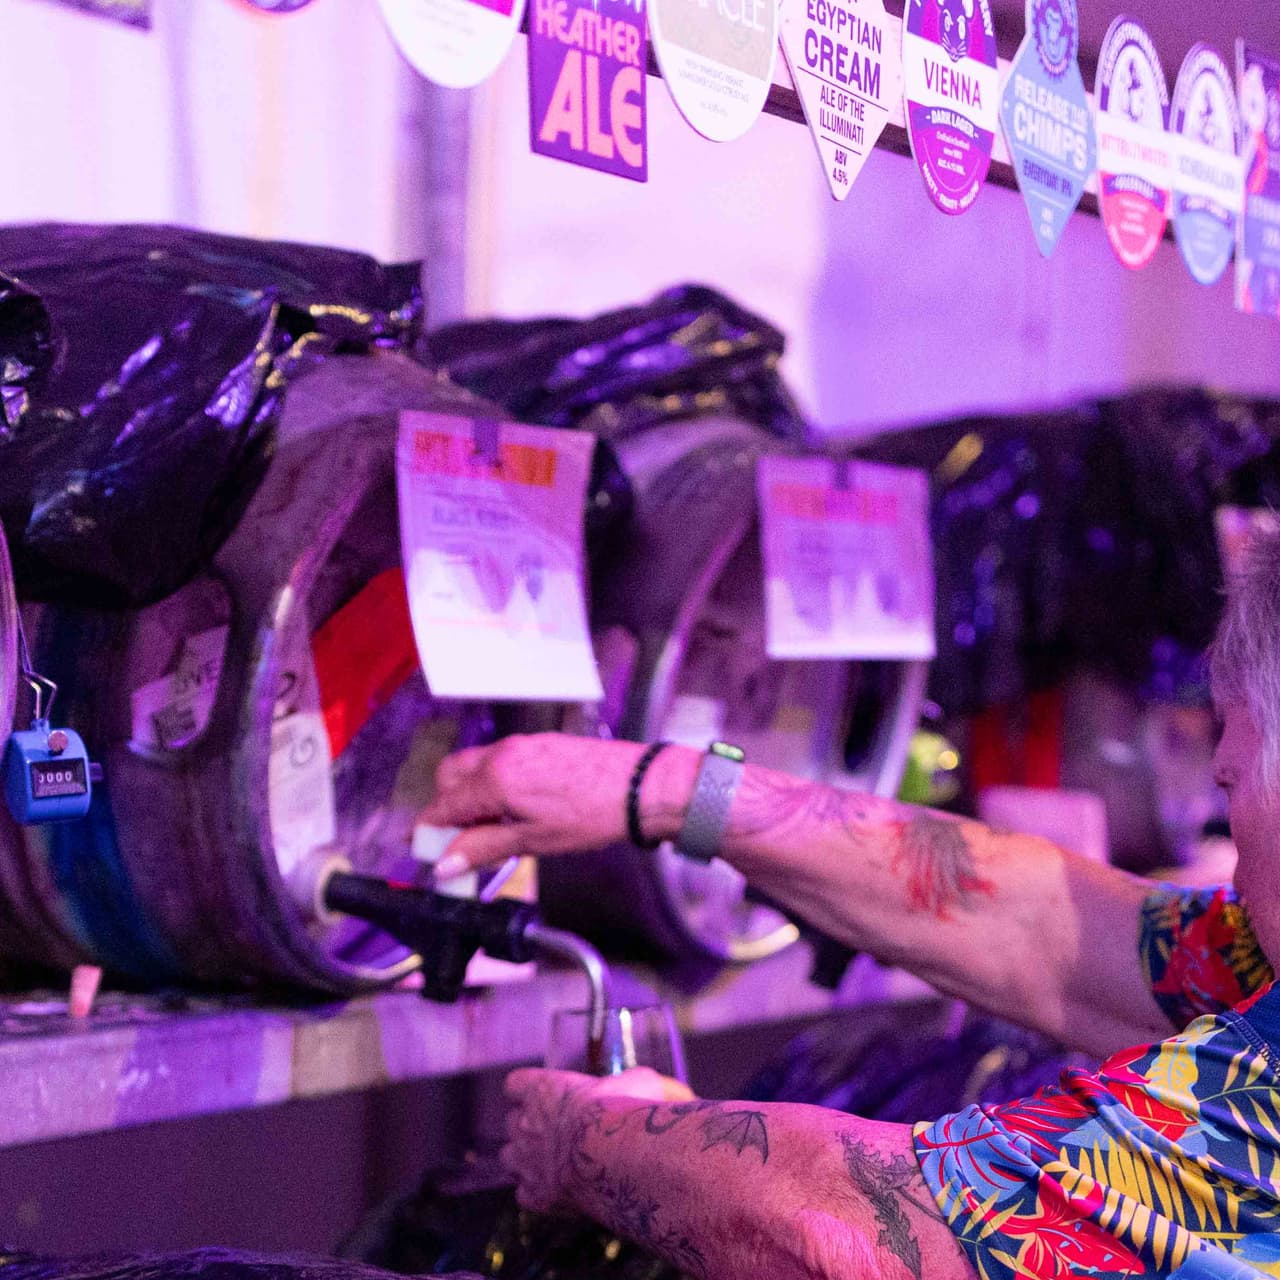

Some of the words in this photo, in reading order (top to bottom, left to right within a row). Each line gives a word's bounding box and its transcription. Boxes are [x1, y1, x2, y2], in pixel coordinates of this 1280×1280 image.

[535, 0, 640, 66] HEATHER
[806, 0, 882, 54] EGYPTIAN
[804, 28, 881, 100] CREAM
[923, 58, 982, 110] VIENNA
[538, 48, 643, 168] ALE
[819, 108, 865, 145] ILLUMINATI
[820, 85, 836, 108] ALE
[837, 92, 849, 113] OF
[849, 96, 865, 122] THE
[834, 149, 848, 168] ABV
[1013, 103, 1087, 171] CHIMPS
